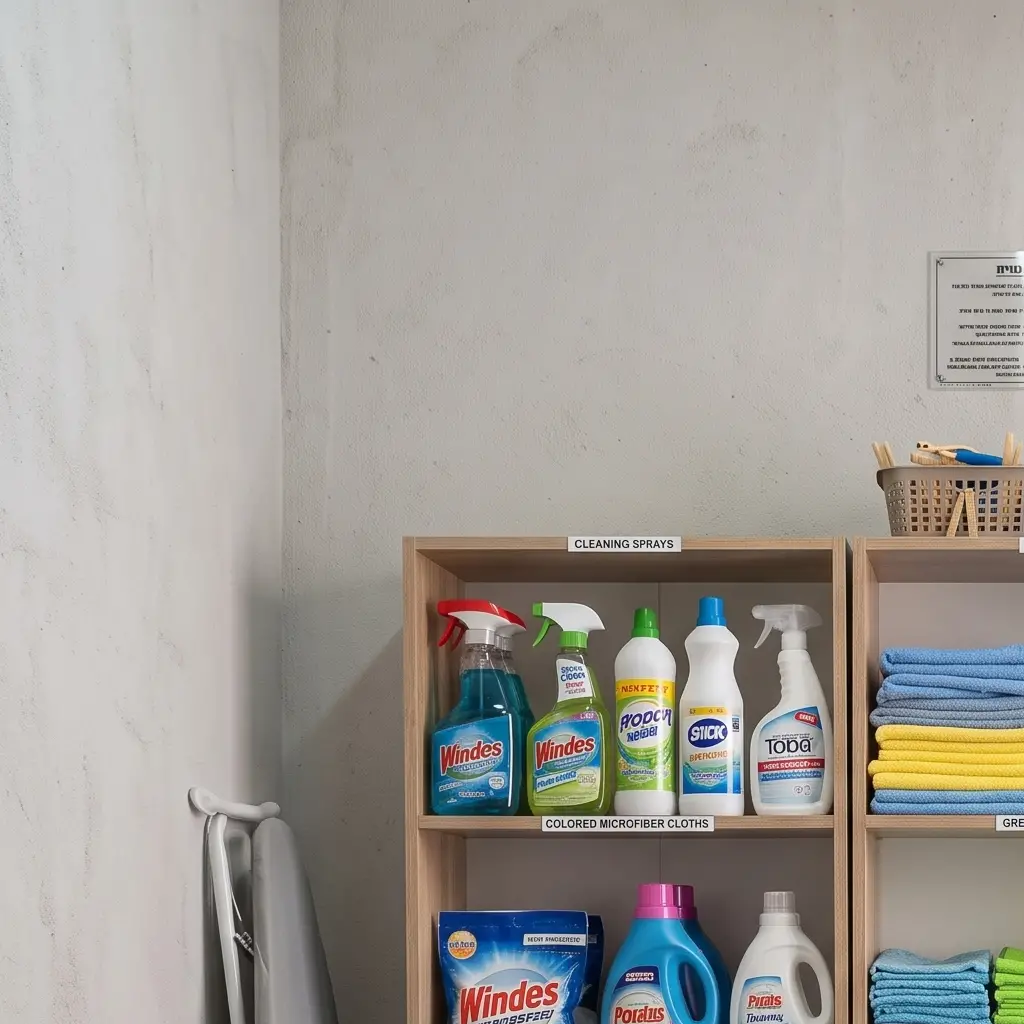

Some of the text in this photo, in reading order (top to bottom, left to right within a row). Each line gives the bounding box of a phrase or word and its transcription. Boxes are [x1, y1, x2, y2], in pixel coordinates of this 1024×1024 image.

[574, 539, 674, 549] CLEANING SPRAYS
[440, 740, 502, 775] Windes
[535, 736, 595, 770] Windes
[545, 819, 709, 829] COLORED MICROFIBER CLOTHS
